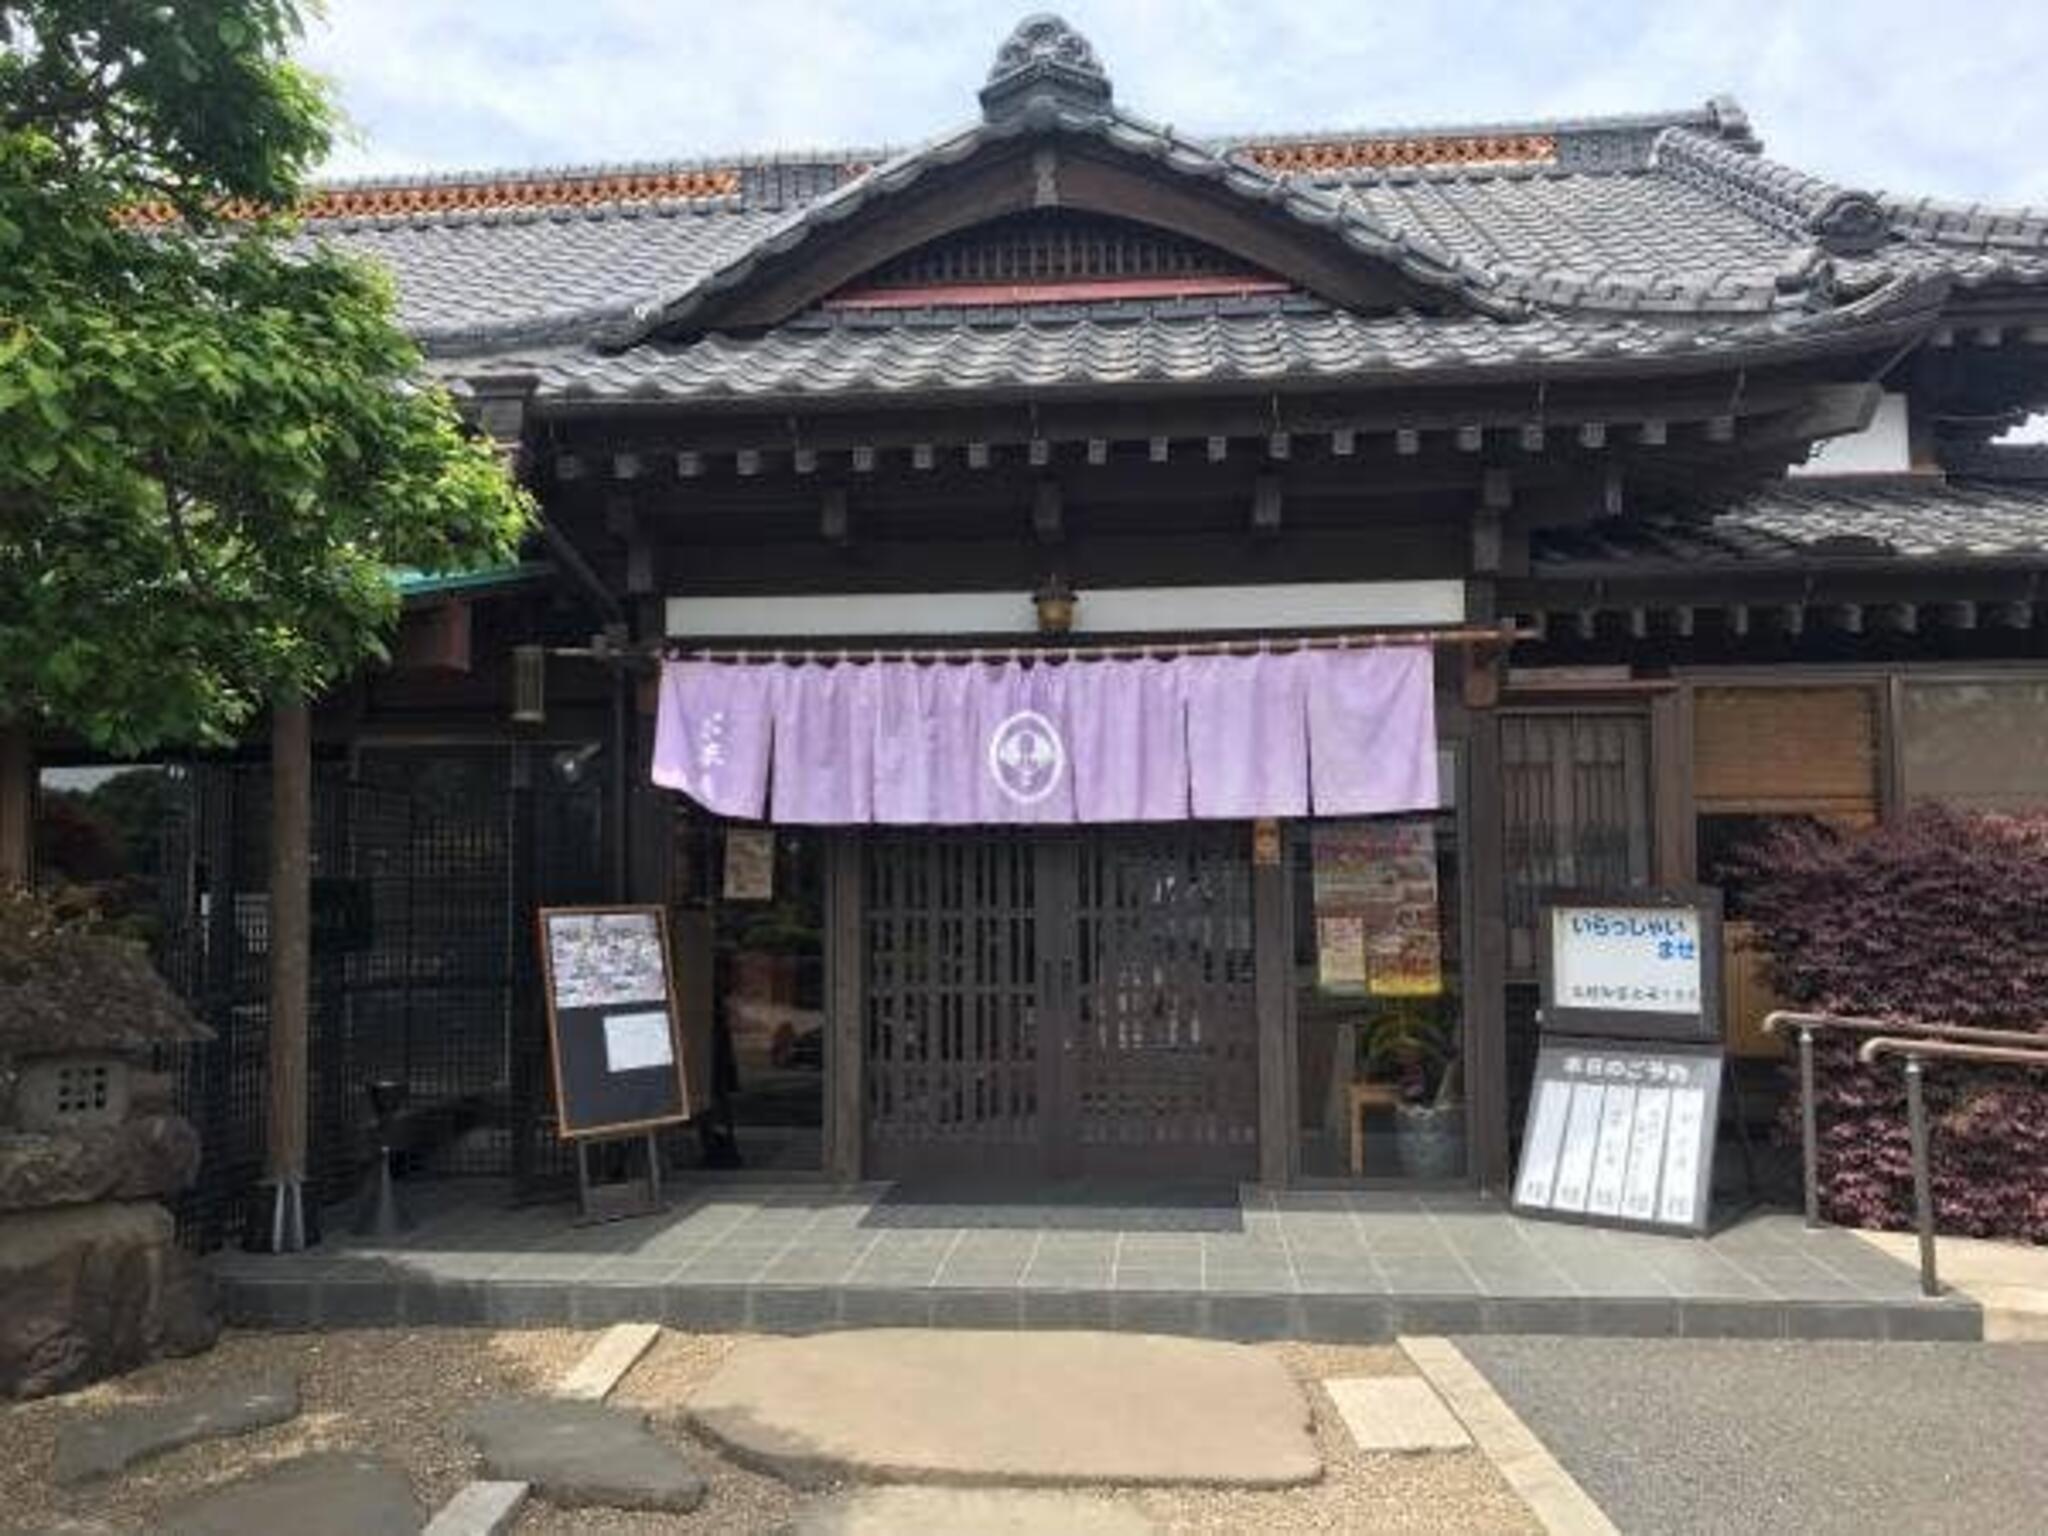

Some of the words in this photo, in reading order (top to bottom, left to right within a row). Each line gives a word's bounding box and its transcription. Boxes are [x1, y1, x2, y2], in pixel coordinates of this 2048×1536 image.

[1572, 914, 1687, 937] いらっしゃい
[1657, 940, 1696, 960] ませ
